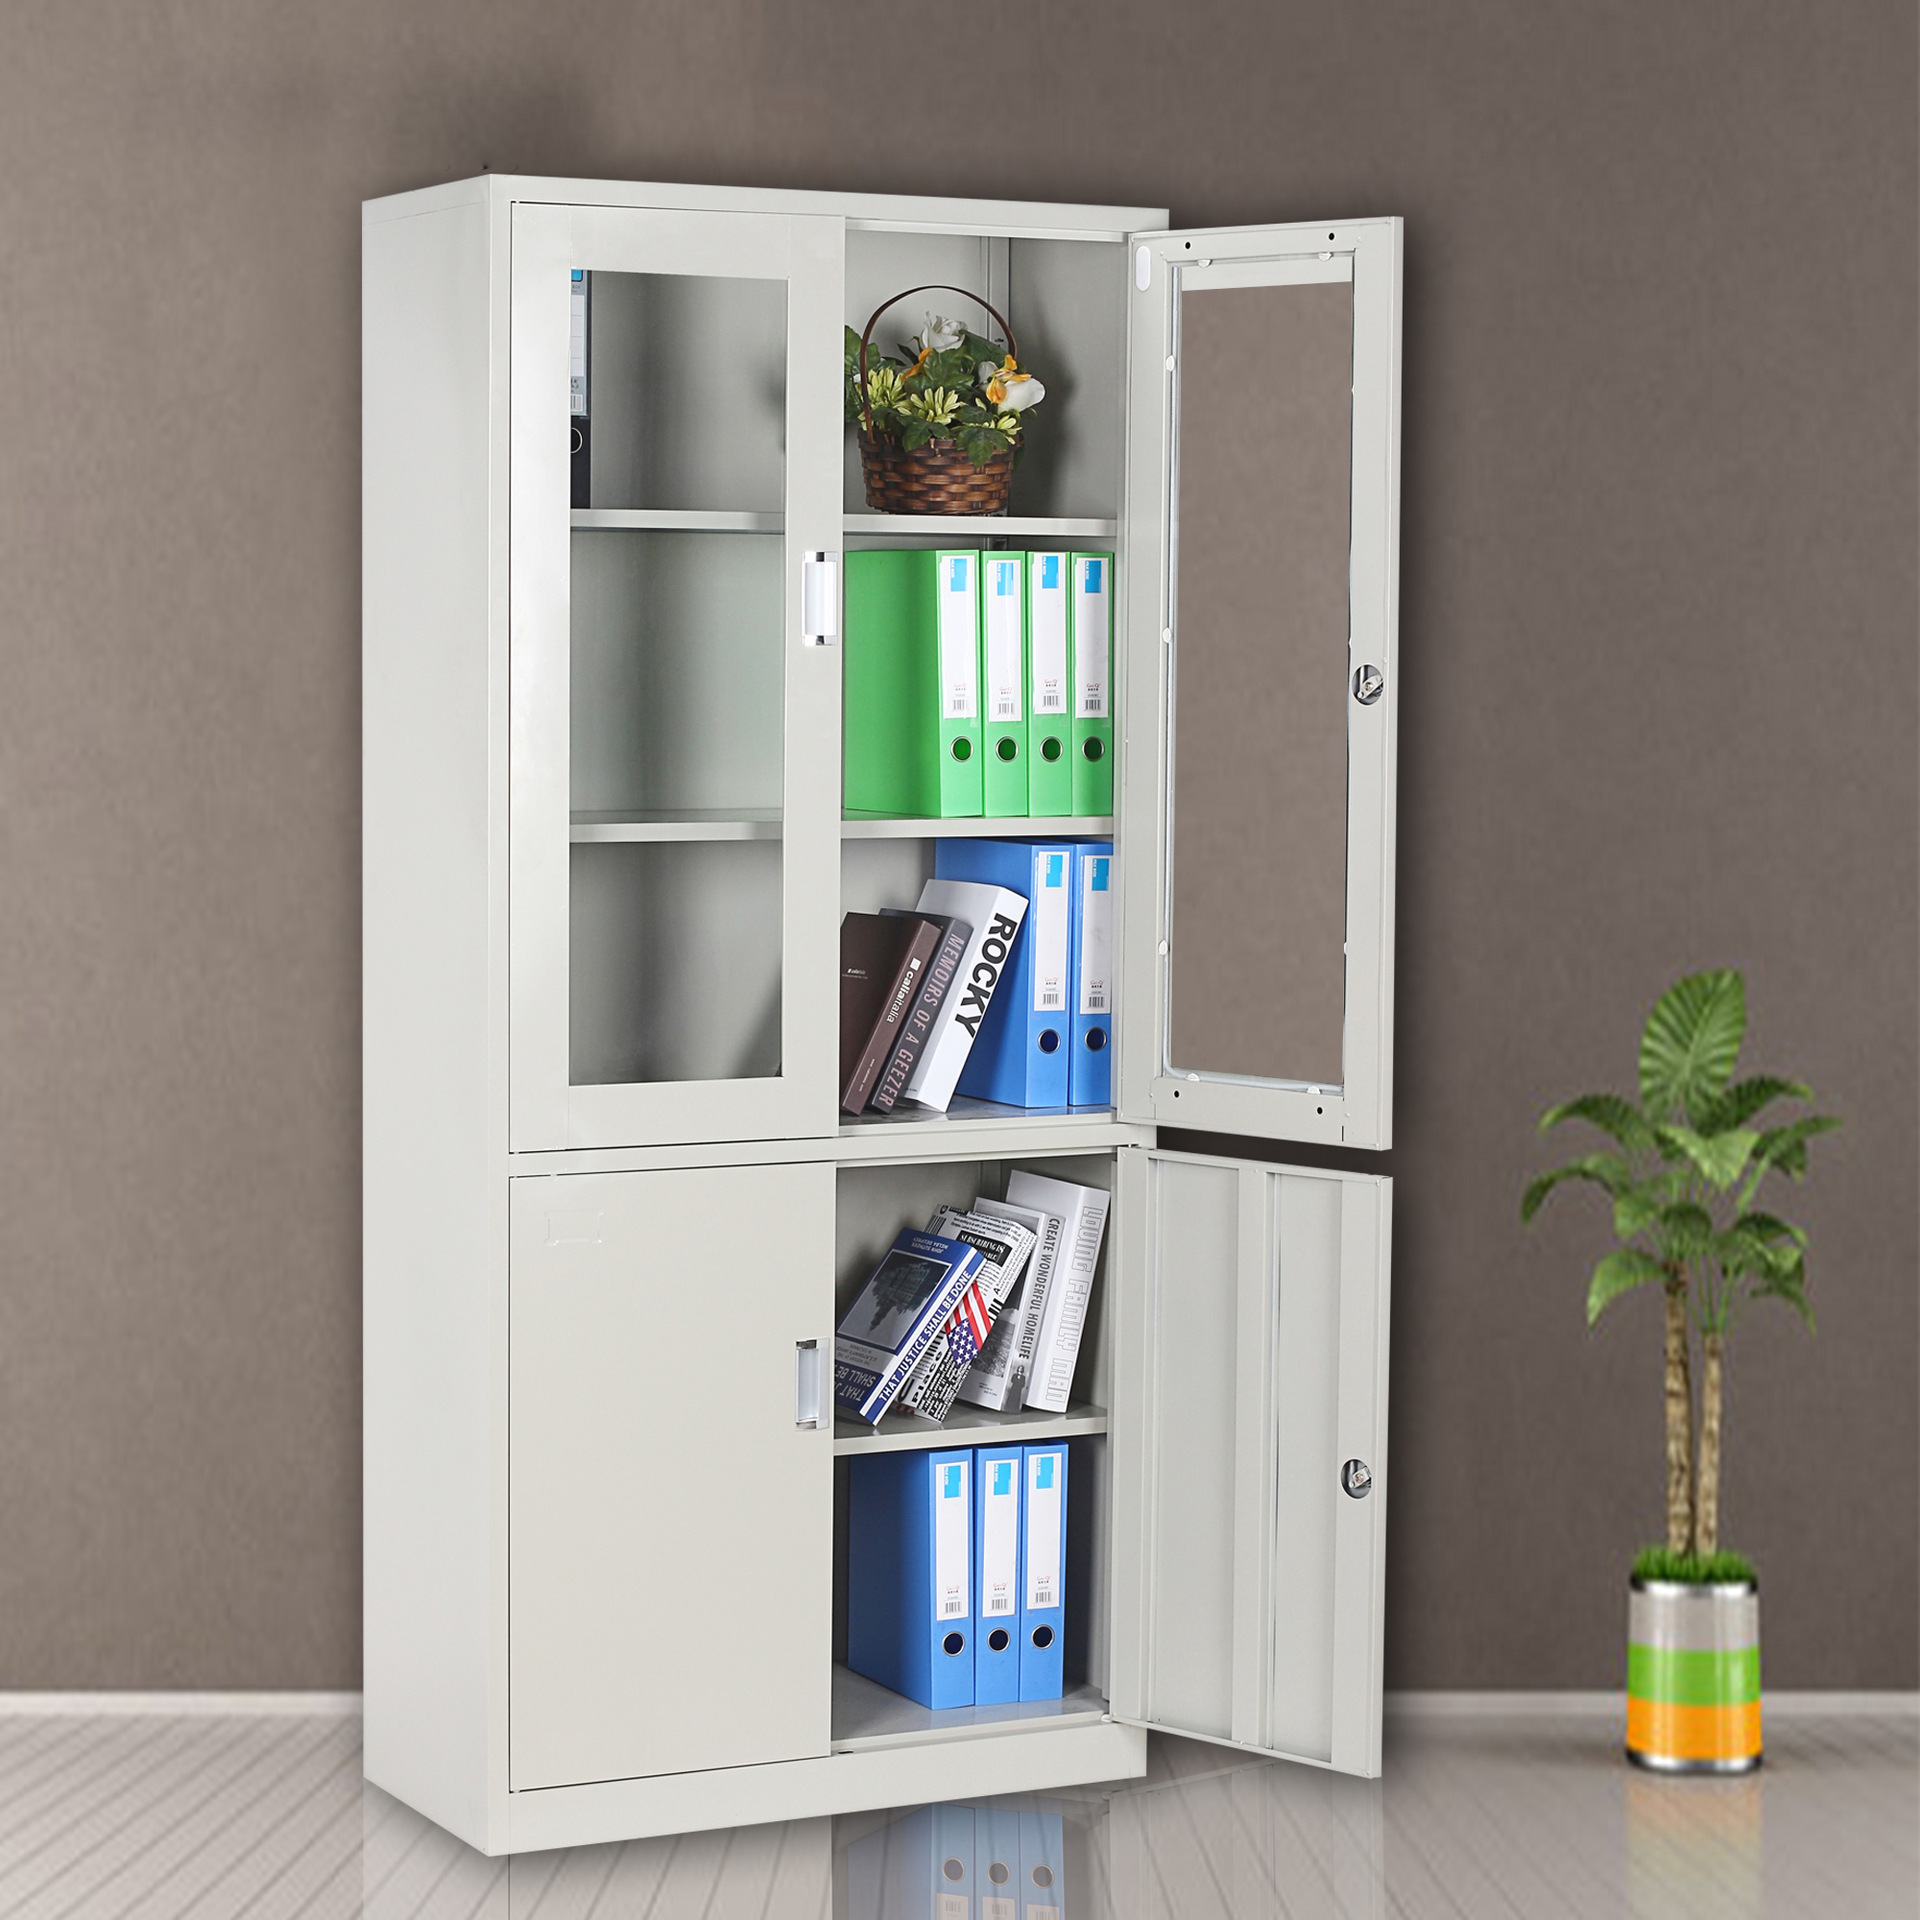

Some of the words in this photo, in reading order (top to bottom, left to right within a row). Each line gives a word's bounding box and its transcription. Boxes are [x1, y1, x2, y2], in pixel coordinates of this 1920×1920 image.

[922, 933, 964, 1006] MEMOIRS
[955, 913, 1018, 1038] ROCKY
[886, 970, 914, 1023] caliaitalia
[912, 1010, 930, 1031] OF
[905, 1035, 920, 1045] A
[878, 1049, 914, 1107] GEEZER
[1045, 1218, 1060, 1258] CREATE
[1072, 1206, 1104, 1272] LOVING
[1029, 1257, 1053, 1311] WONDERFUL
[879, 1376, 899, 1401] THAT
[898, 1335, 927, 1377] JUSTICE
[924, 1307, 946, 1337] SHALL
[942, 1294, 955, 1309] BE
[951, 1270, 972, 1297] DONE
[1018, 1313, 1040, 1359] HOMELIFE
[1056, 1278, 1088, 1351] FAMILY
[840, 1385, 865, 1401] THAT
[851, 1369, 876, 1387] SHALL
[1045, 1359, 1076, 1404] MAN
